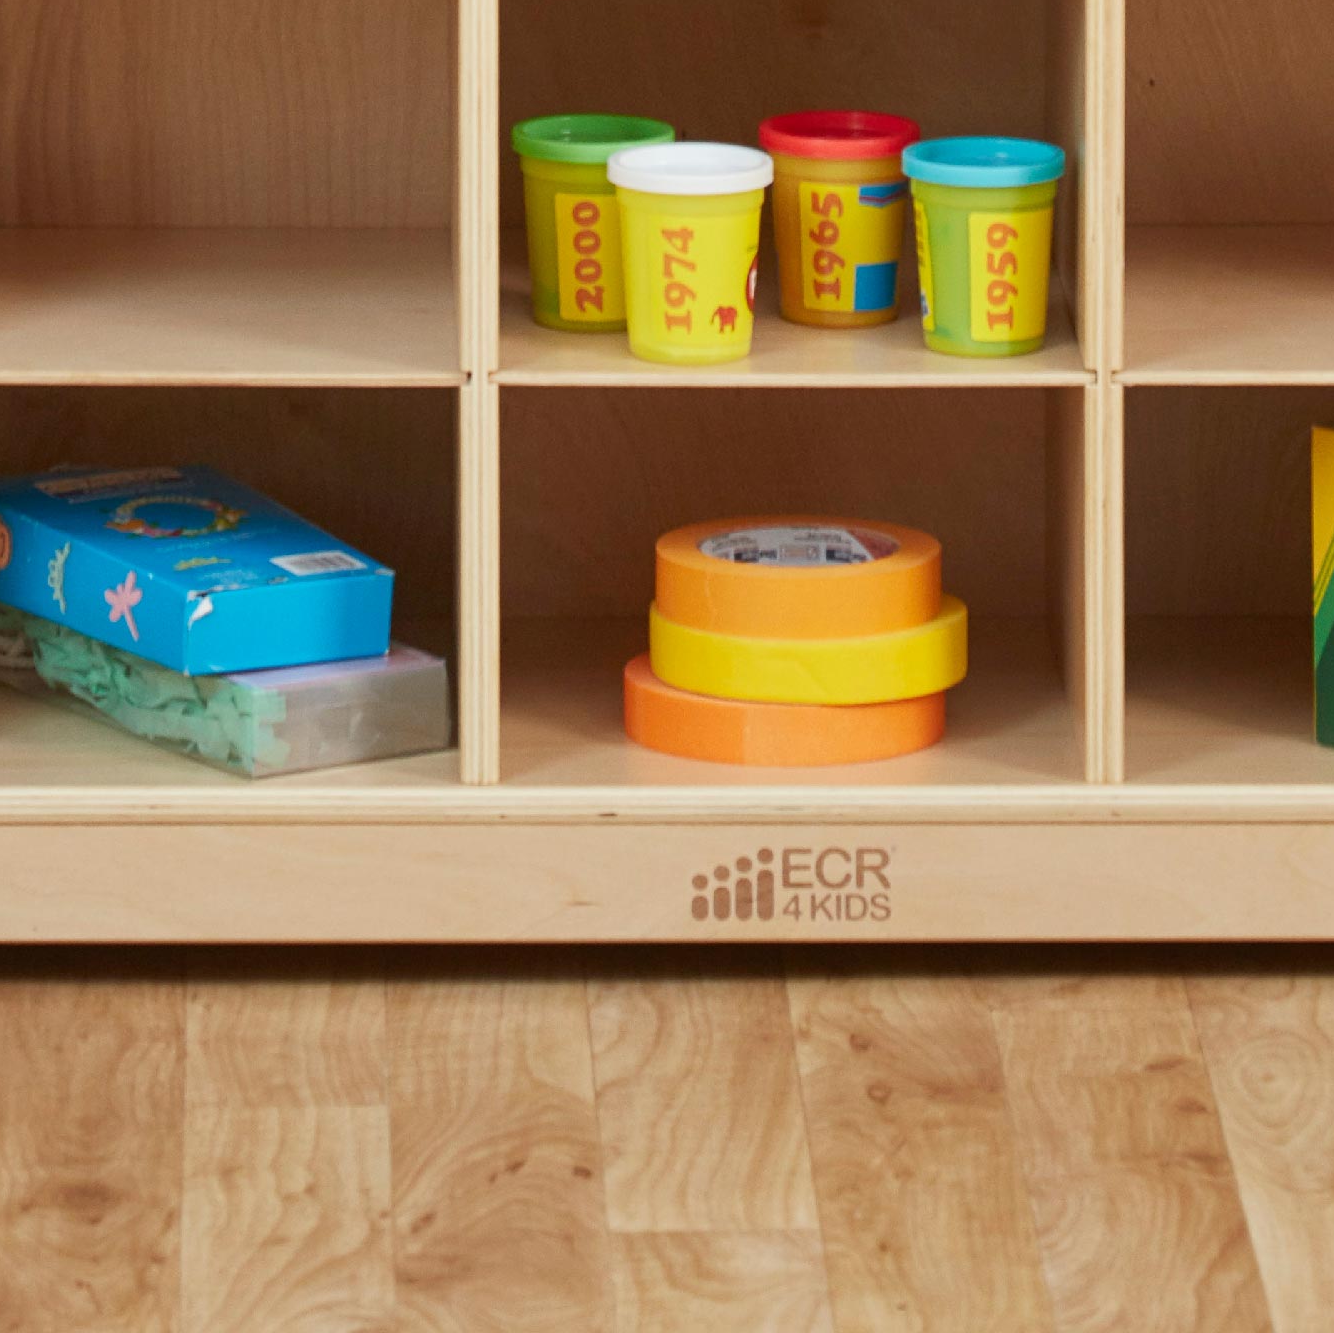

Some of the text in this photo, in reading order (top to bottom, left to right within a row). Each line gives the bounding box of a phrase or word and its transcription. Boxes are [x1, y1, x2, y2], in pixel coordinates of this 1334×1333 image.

[572, 201, 604, 314] 2000
[661, 225, 697, 335] 1974
[809, 191, 845, 302] 1965
[986, 221, 1019, 332] 1959
[781, 847, 891, 889] ECR
[810, 894, 892, 921] KIDS
